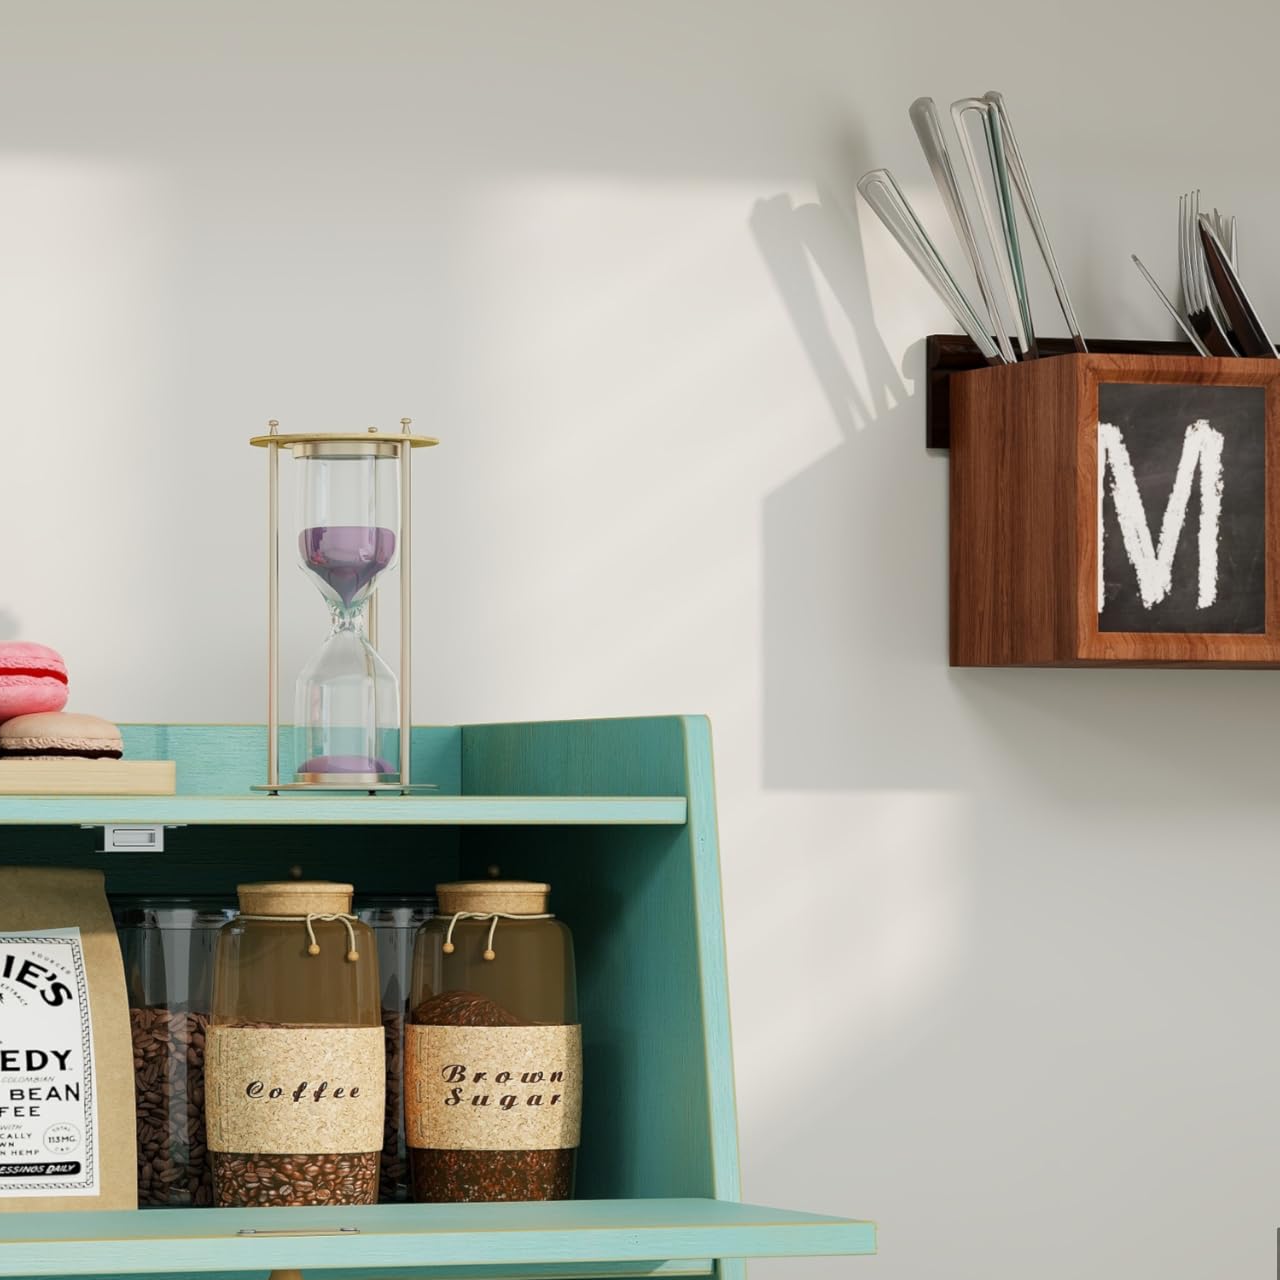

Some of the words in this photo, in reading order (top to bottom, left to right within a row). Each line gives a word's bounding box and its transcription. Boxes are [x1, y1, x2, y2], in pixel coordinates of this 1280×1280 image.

[1098, 418, 1224, 614] M
[441, 1064, 564, 1083] Brown
[10, 1082, 80, 1101] BEAN
[246, 1080, 361, 1102] Coffee
[444, 1087, 561, 1110] Sugar
[45, 1164, 76, 1174] DAILY
